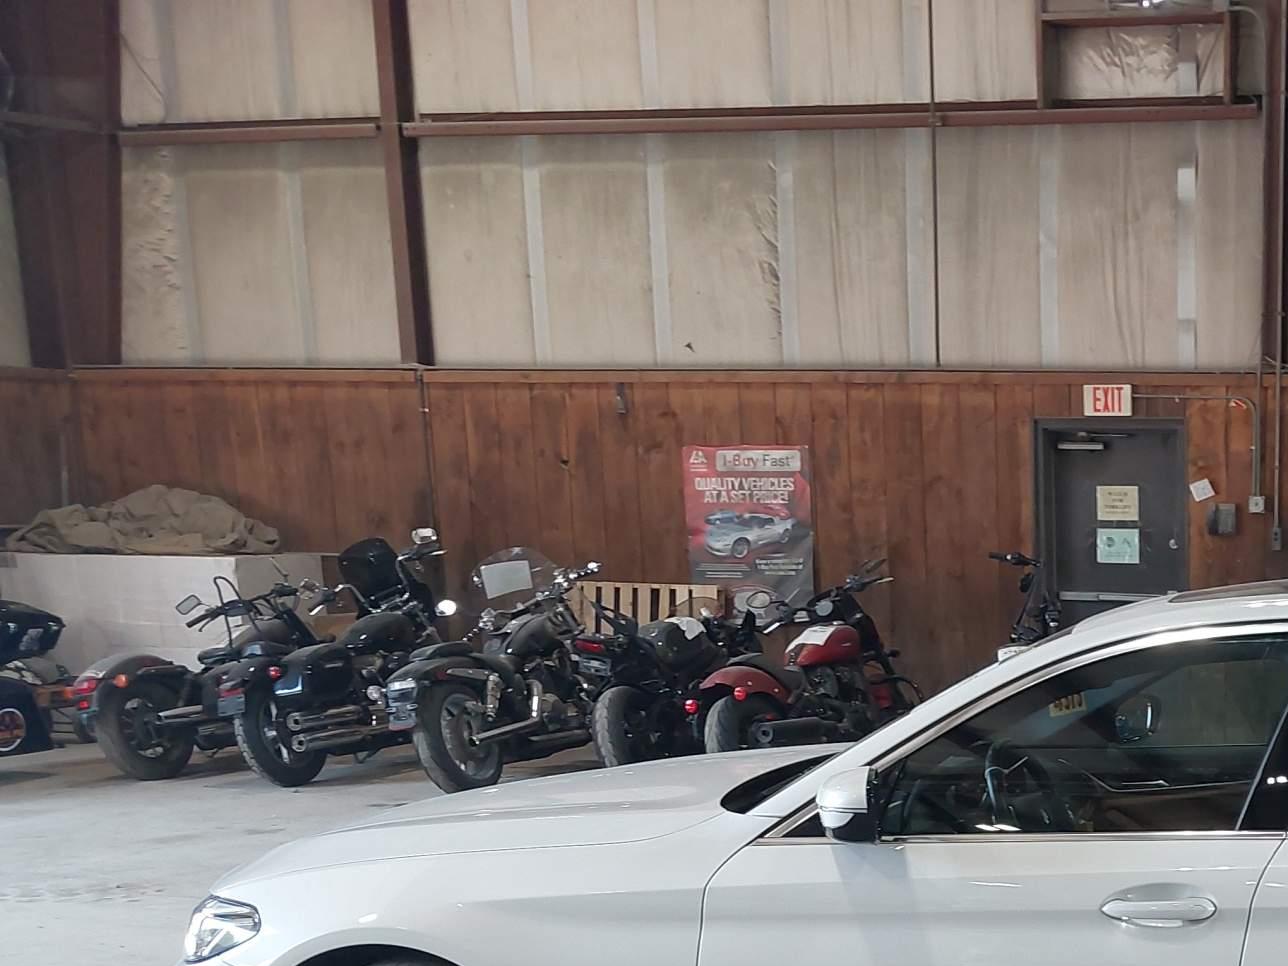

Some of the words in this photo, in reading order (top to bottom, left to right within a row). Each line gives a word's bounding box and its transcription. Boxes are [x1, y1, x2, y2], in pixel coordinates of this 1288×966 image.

[1093, 386, 1124, 412] EXIT
[694, 477, 740, 491] QUALITY
[740, 477, 795, 491] VEHICLES
[704, 490, 719, 503] AT
[719, 491, 729, 503] A
[731, 491, 751, 503] SET
